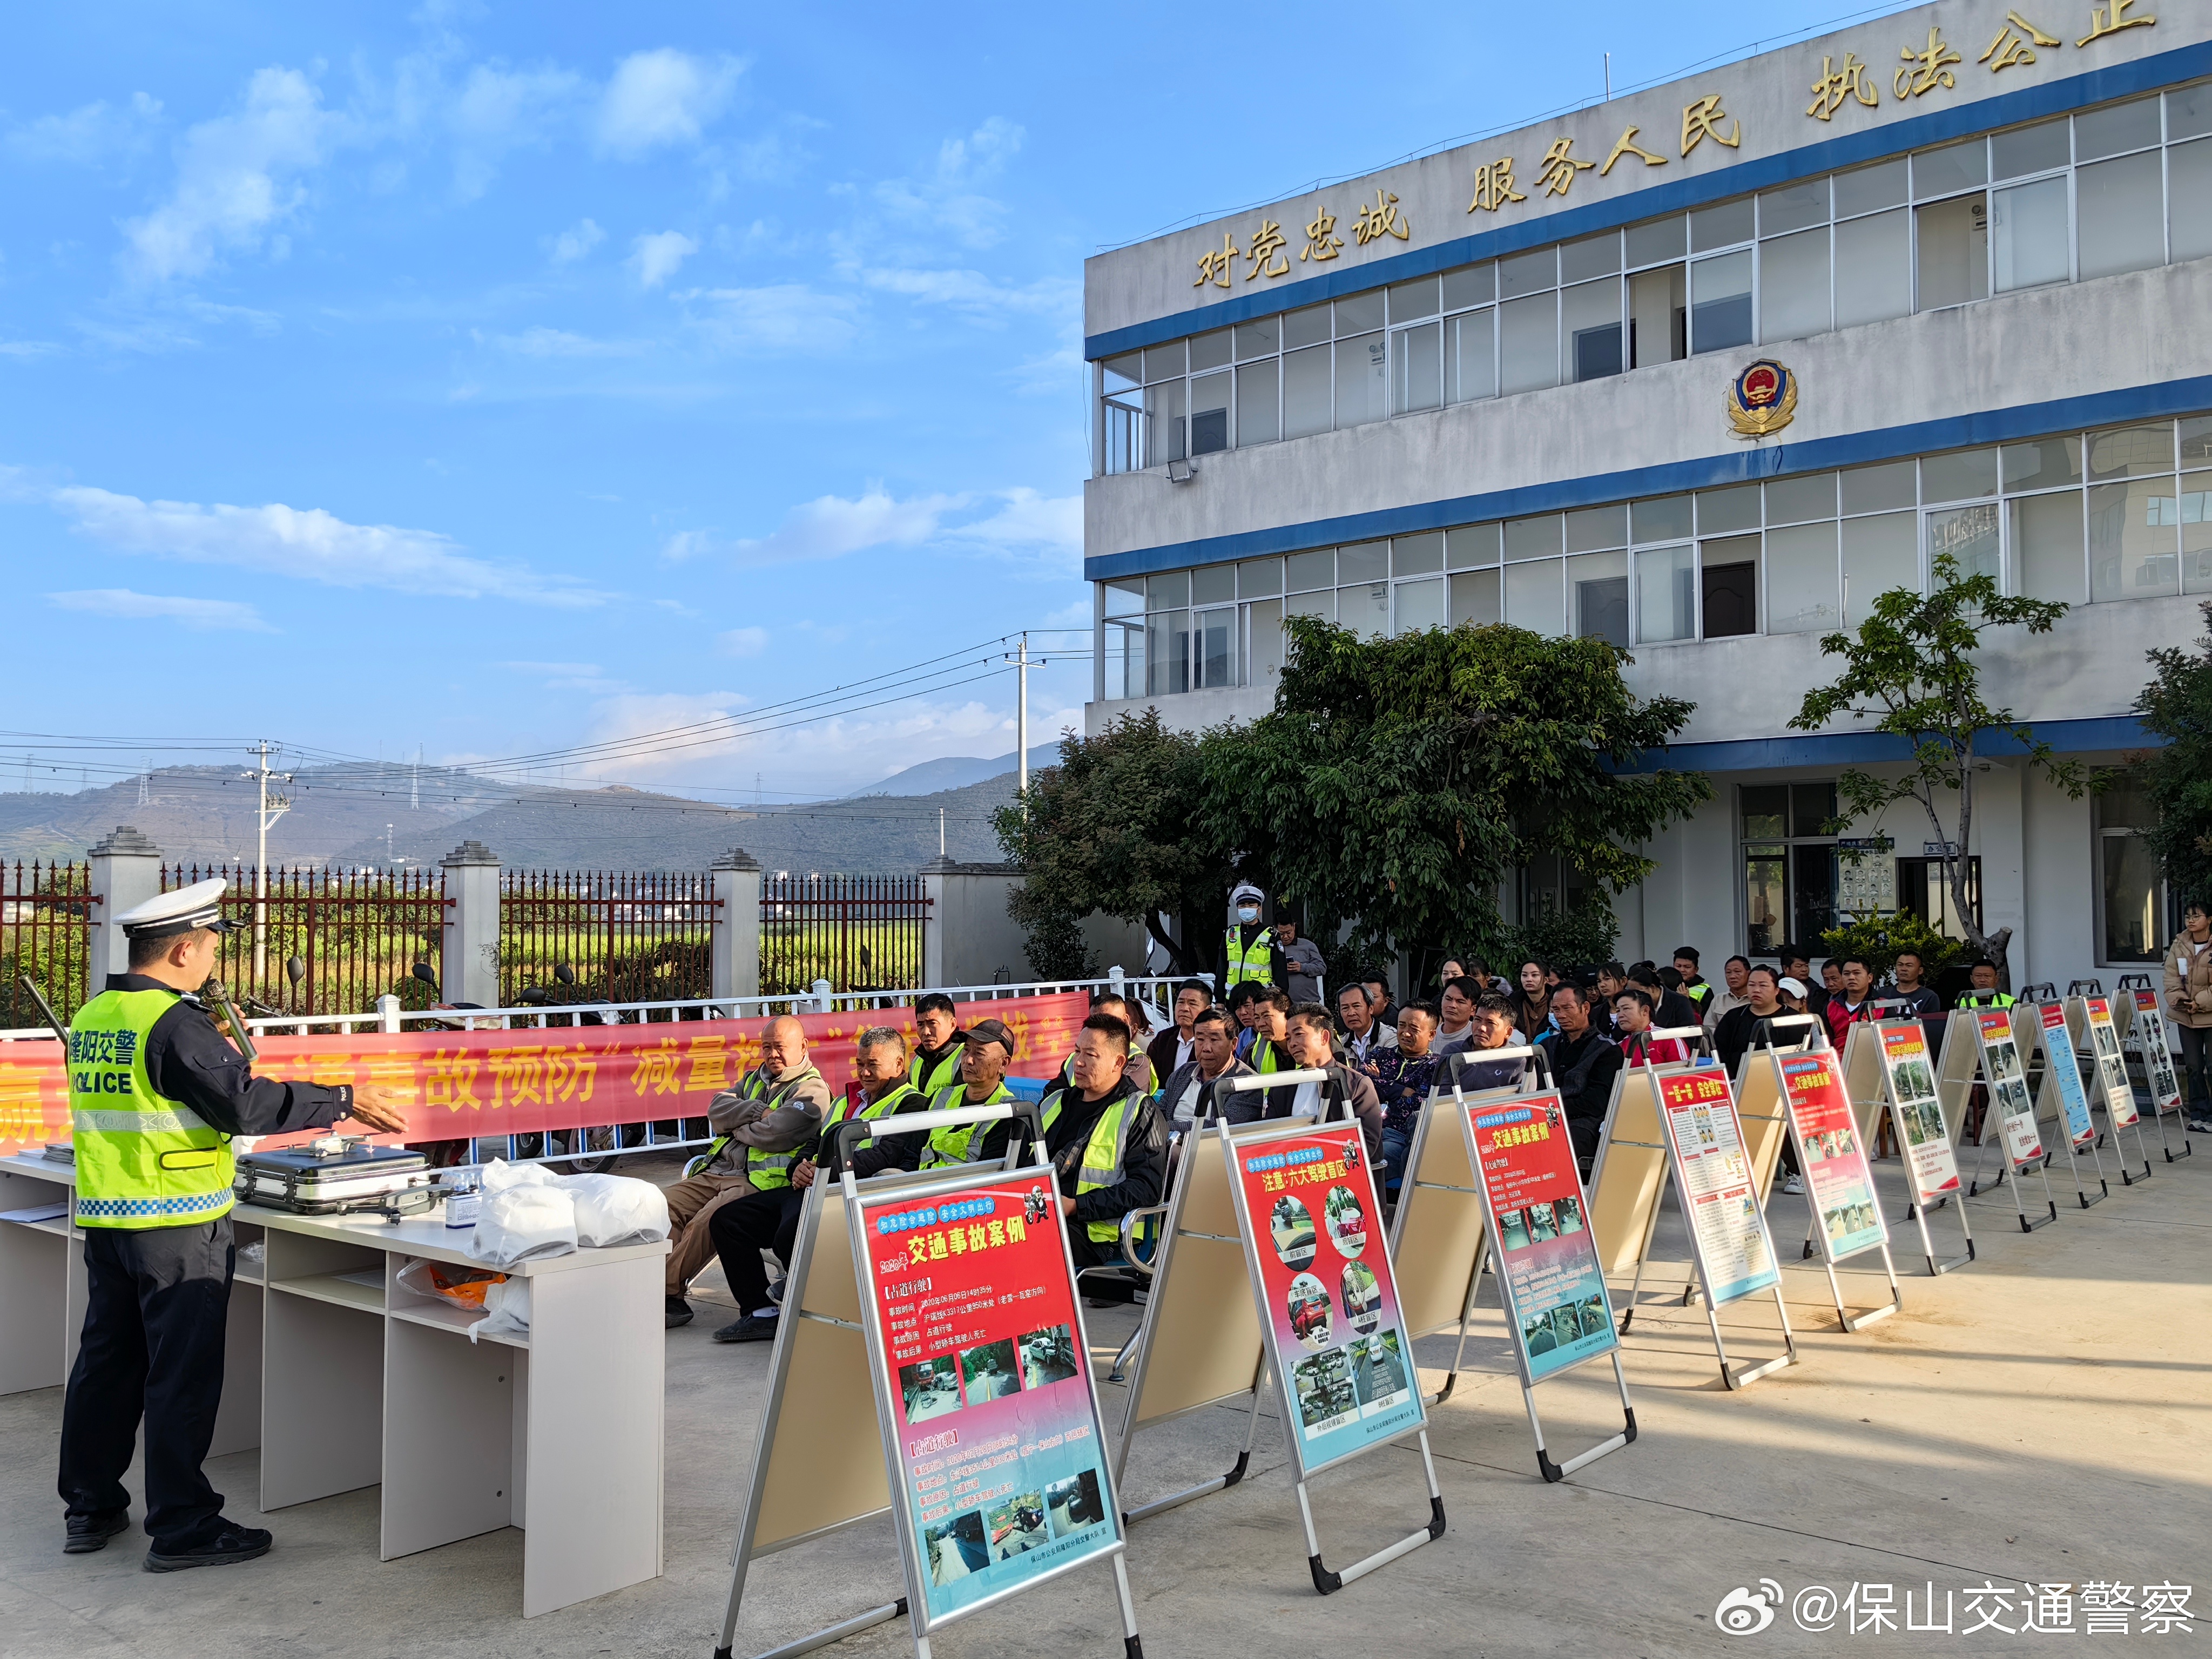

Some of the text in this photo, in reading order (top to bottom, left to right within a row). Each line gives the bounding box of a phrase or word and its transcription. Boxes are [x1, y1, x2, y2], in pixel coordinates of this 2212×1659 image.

[1193, 0, 2156, 288] 对党忠诚 服务人民 执法公正
[70, 1029, 137, 1065] 隆阳交警
[72, 1072, 133, 1094] POLICE
[1491, 1121, 1551, 1150] 交通事故案例
[879, 1199, 995, 1230] 知危险会避险 安全文明出行
[878, 1214, 1027, 1275] 2020年 交通事故案例
[1343, 1235, 1359, 1245] 后盲区
[1289, 1247, 1307, 1259] 前盲区
[1294, 1285, 1318, 1297] 车底盲区
[1316, 1414, 1346, 1434] 外后视镜盲区
